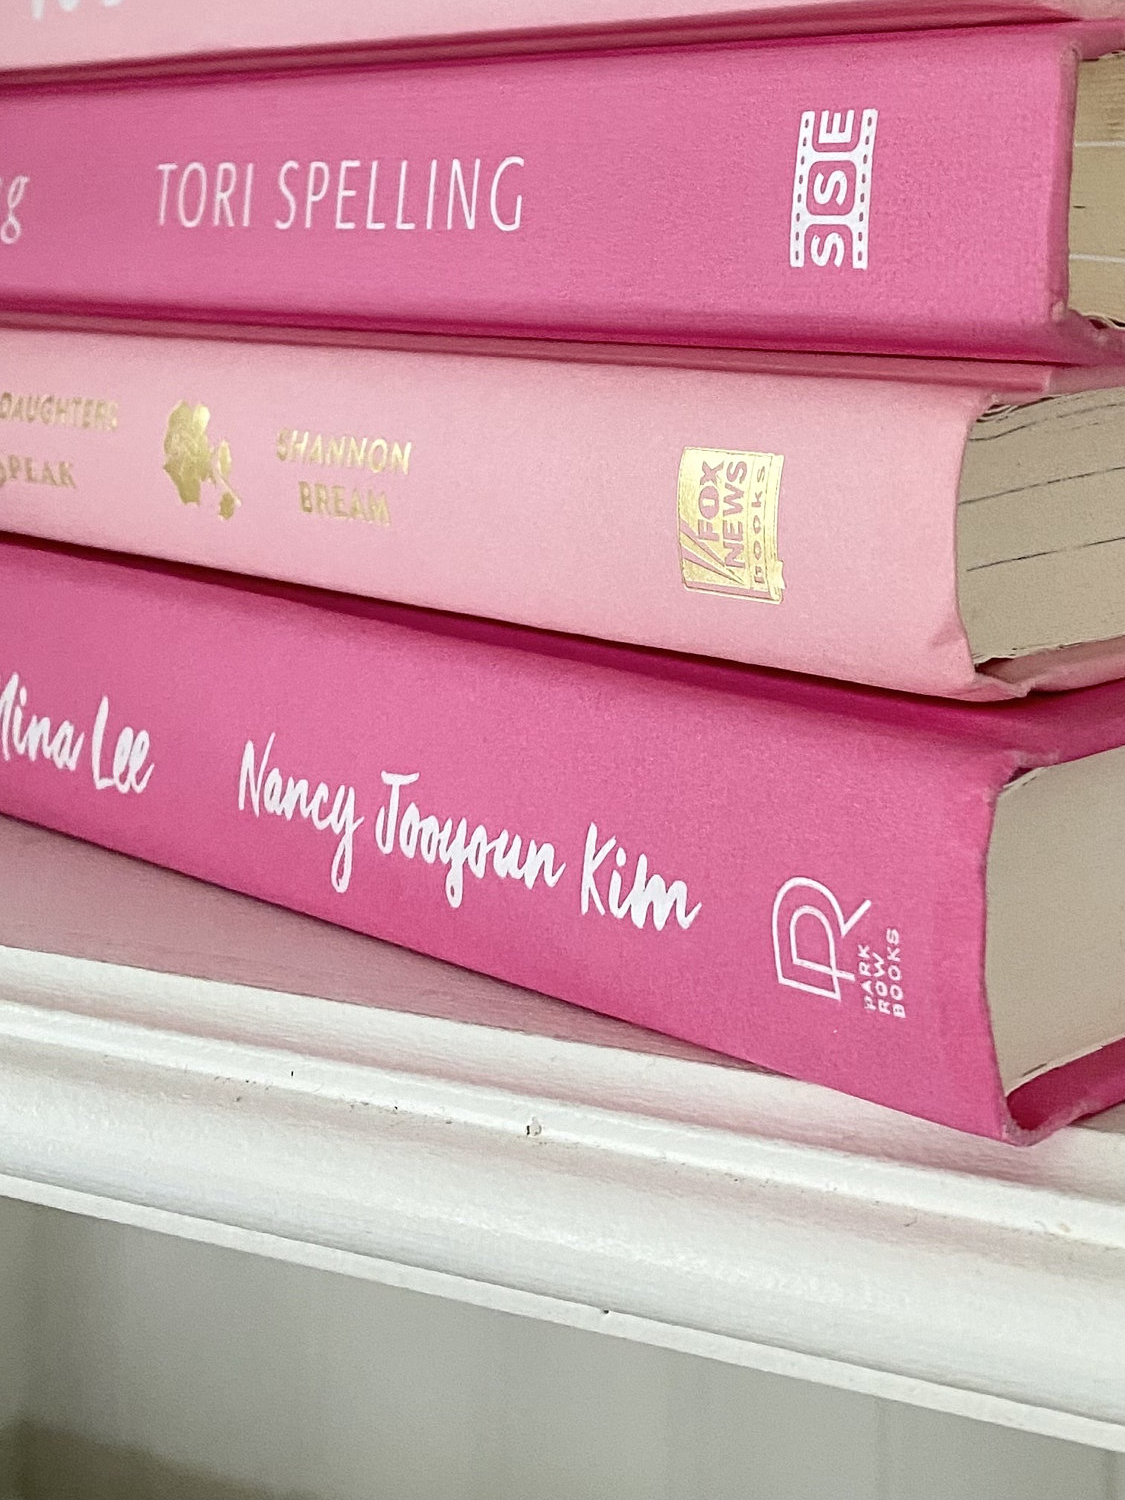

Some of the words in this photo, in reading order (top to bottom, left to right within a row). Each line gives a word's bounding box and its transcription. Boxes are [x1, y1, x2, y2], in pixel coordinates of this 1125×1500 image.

[156, 161, 254, 228] TORI
[276, 155, 525, 232] SPELLING
[276, 427, 412, 476] SHANNON
[298, 481, 392, 527] BREAM
[697, 460, 724, 542] FOX
[722, 460, 748, 569] NEWS
[752, 465, 766, 584] BOOKS
[91, 695, 155, 794] Lee
[238, 731, 365, 893] Nancy
[375, 770, 567, 909] Jooyoun
[580, 822, 702, 931] Kim
[857, 944, 877, 1011] PARK
[872, 952, 892, 1015] ROW
[886, 927, 907, 1019] BOOKS
